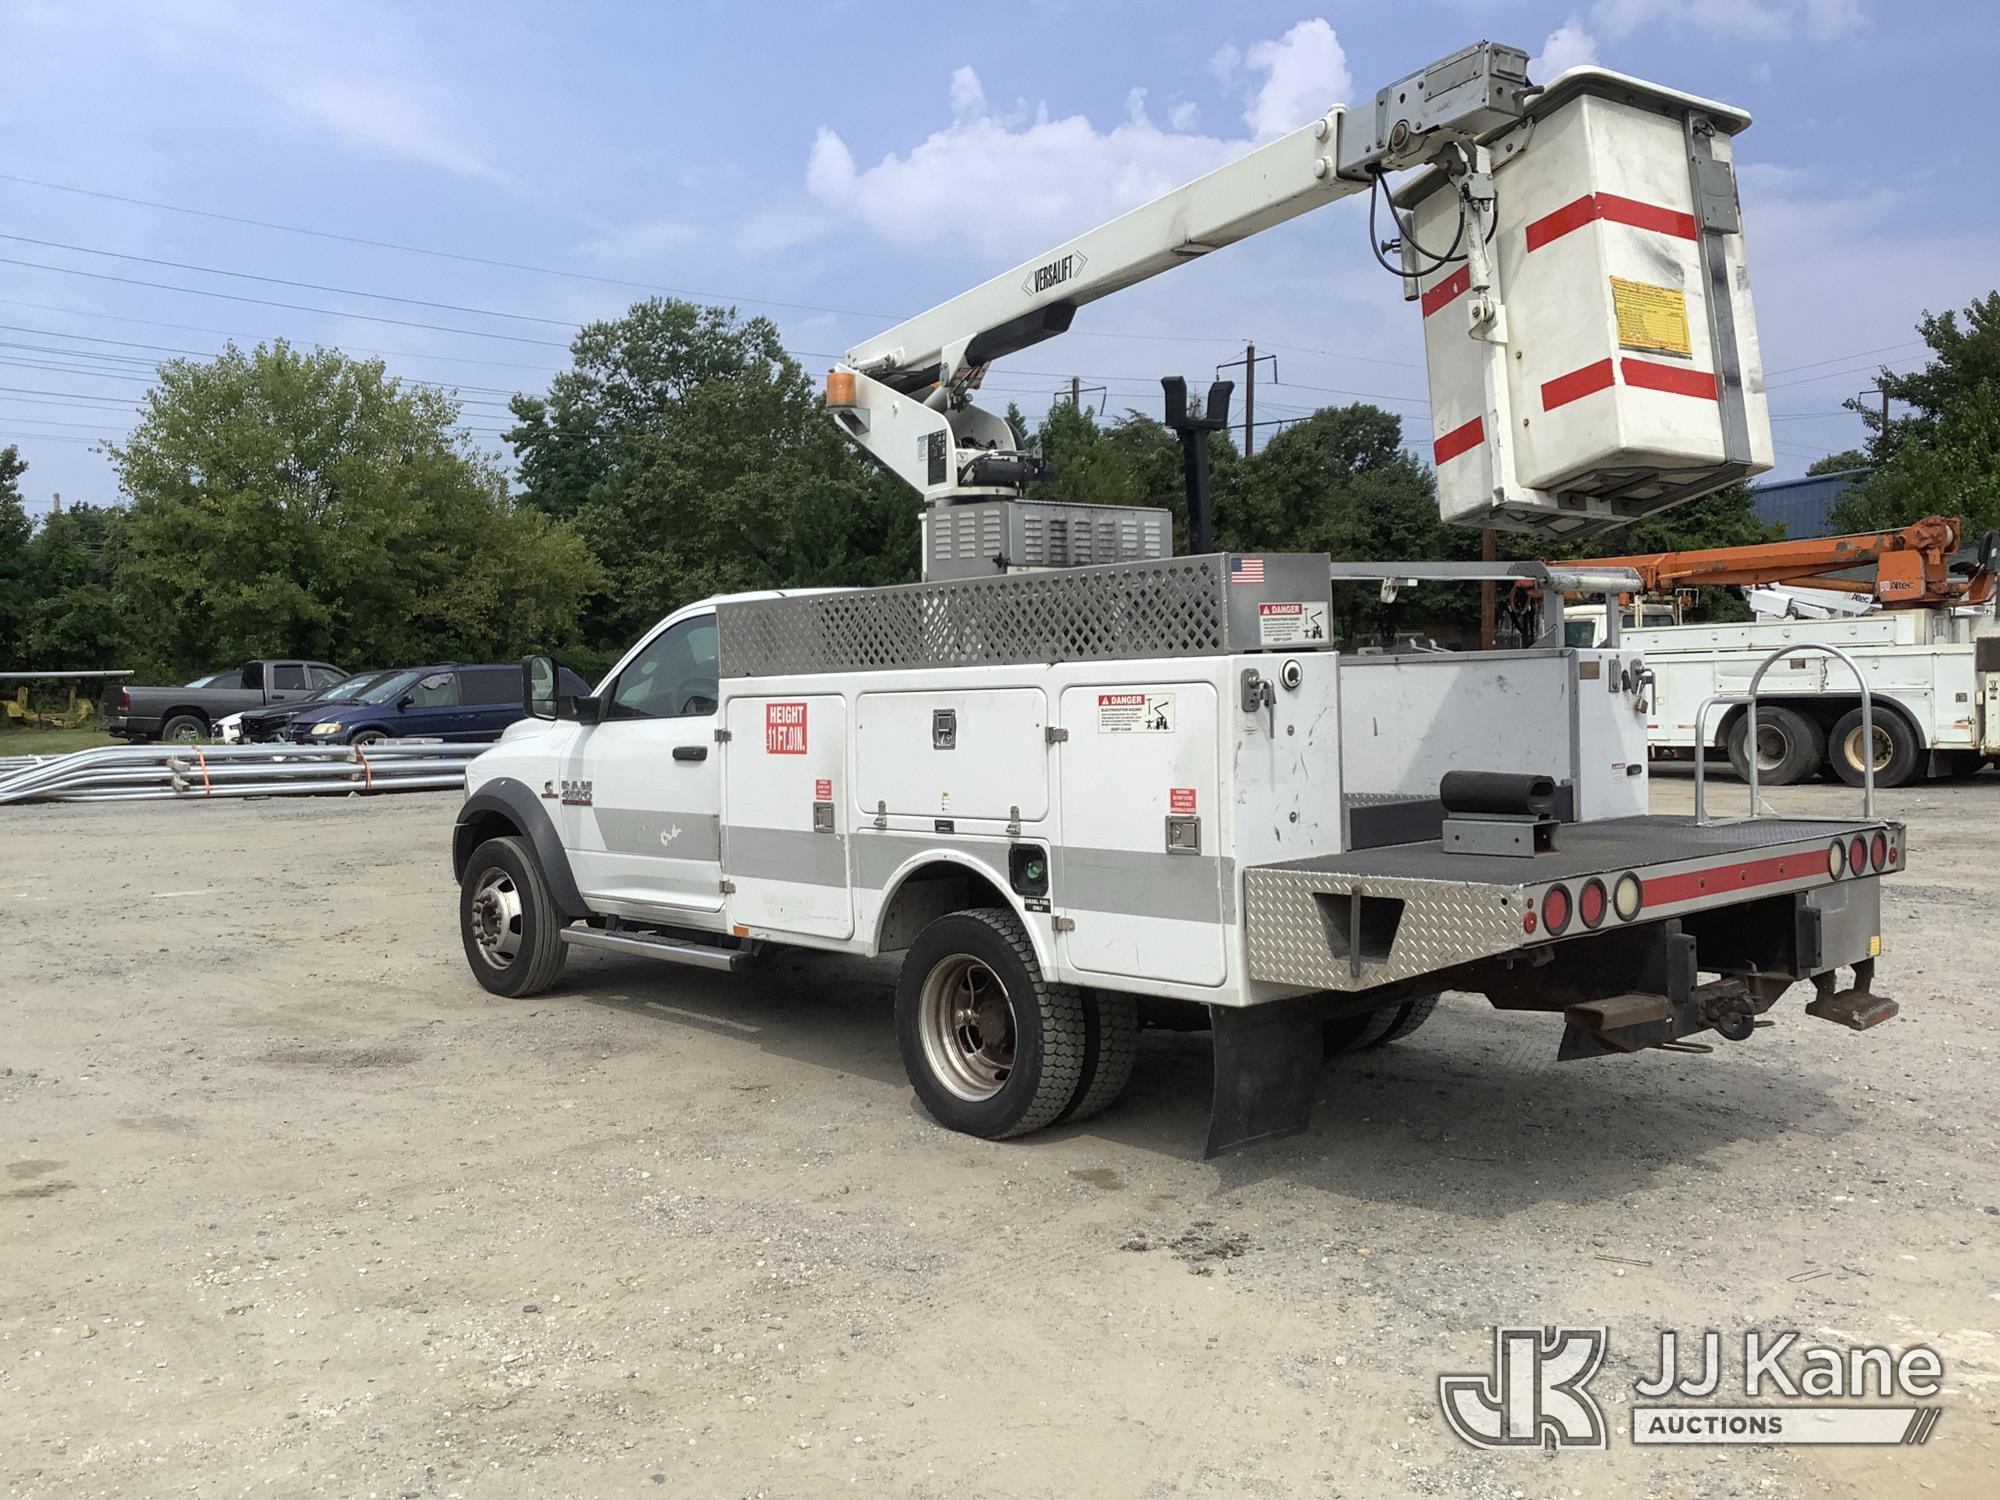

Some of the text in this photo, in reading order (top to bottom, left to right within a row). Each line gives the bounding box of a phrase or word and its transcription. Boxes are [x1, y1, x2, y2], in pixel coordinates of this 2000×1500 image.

[1034, 254, 1074, 293] VERSALIFT
[1890, 581, 1914, 590] Altec
[1272, 605, 1300, 614] DANGER
[1111, 696, 1142, 705] DANGER
[770, 706, 804, 724] HEIGHT
